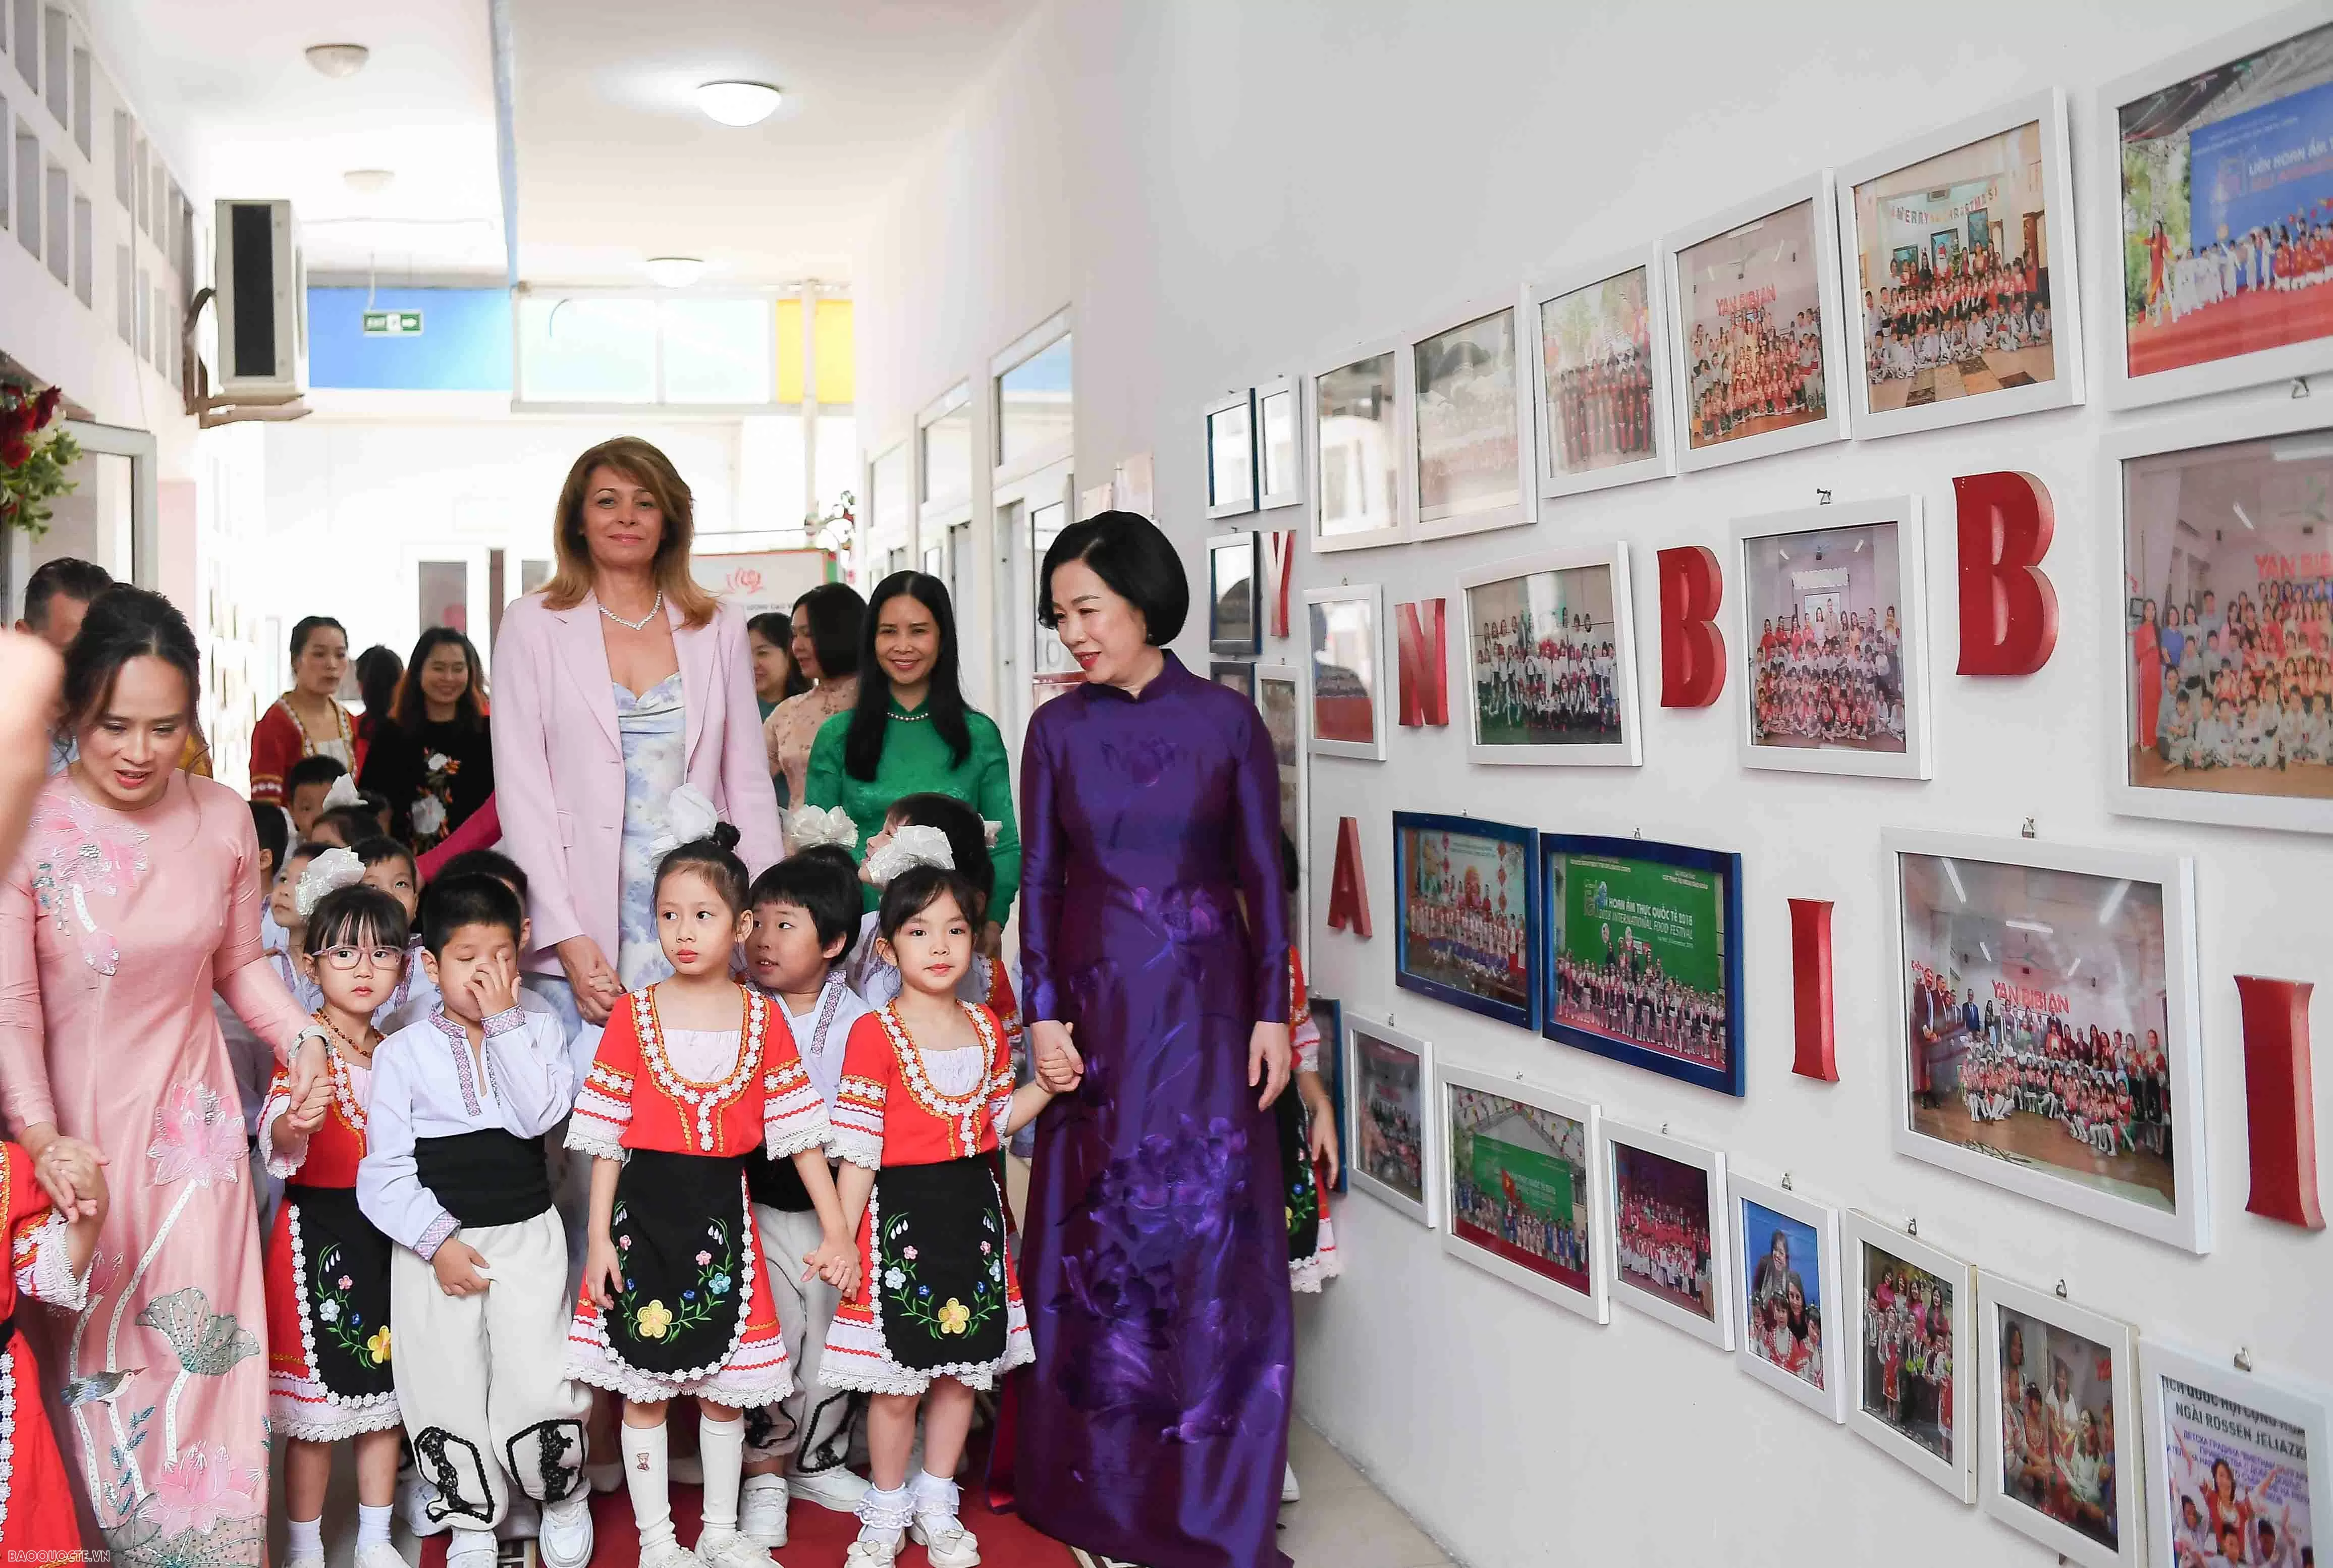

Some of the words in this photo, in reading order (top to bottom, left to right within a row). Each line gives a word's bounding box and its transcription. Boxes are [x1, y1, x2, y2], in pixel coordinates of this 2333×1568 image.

[1654, 921, 1668, 934] FOOD
[1669, 924, 1693, 940] FESTIVAL
[1992, 979, 2019, 1005] YAN
[2022, 988, 2070, 1014] BIBIAN
[2175, 1401, 2202, 1425] NGÀI
[2204, 1413, 2252, 1442] ROSSEN
